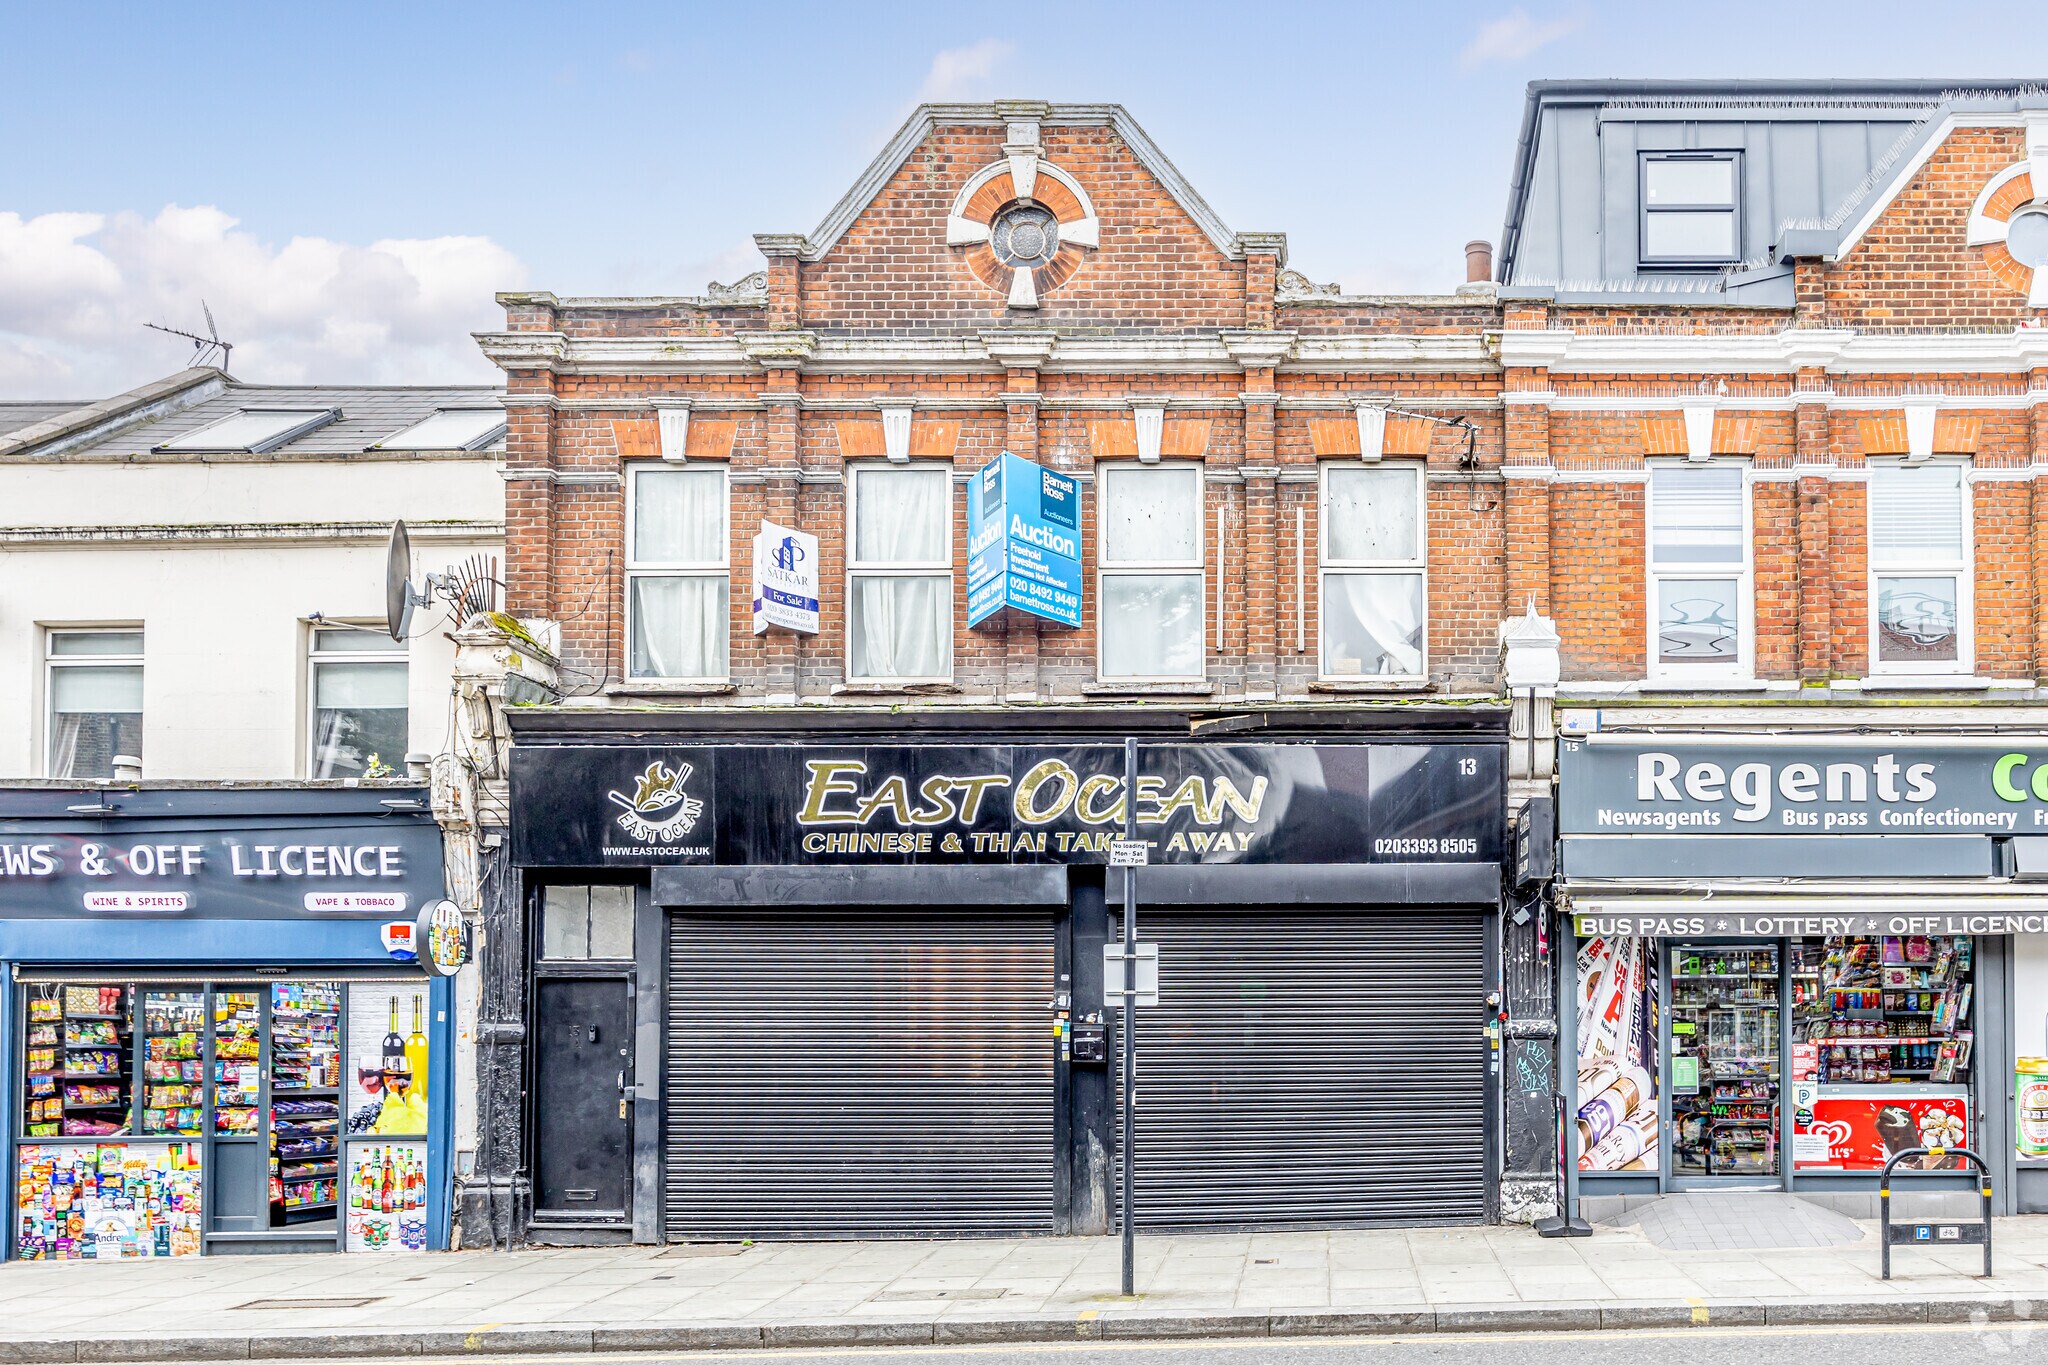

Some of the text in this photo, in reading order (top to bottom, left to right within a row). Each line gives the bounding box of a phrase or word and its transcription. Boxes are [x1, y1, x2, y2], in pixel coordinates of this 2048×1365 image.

[1042, 471, 1074, 495] Barnett
[1042, 483, 1065, 502] Ross
[1009, 513, 1075, 557] Auction
[1009, 541, 1042, 562] Freehold
[1010, 553, 1050, 575] Investment
[767, 566, 809, 587] SATKAR
[773, 590, 803, 607] For Sale
[1009, 576, 1028, 593] 020
[1029, 583, 1053, 602] 8492
[1054, 590, 1078, 609] 9449
[1009, 589, 1077, 621] barnettross.co.uk
[1565, 742, 1579, 752] 15
[1458, 758, 1477, 775] 13
[796, 758, 1269, 826] EAST OCEAN
[1637, 752, 1938, 822] Regents
[1598, 808, 1722, 830] Newsagents
[1782, 809, 1819, 826] Bus
[1824, 812, 1868, 830] pass
[1879, 808, 2018, 830] Confectionery
[602, 846, 710, 856] WWW.EASTOCEAN.UK
[802, 832, 933, 853] CHINESE
[940, 833, 965, 853] &
[970, 832, 1047, 852] THAI
[1055, 832, 1128, 852] TAK
[1165, 832, 1256, 852] AWAY
[1374, 838, 1477, 854] 0203393 8505
[0, 843, 401, 876] WS & OFF LICENCE
[92, 897, 183, 907] WINE & SPIRITS
[315, 898, 395, 906] VAPE & TOBBACO
[1580, 918, 1632, 936] BUS
[1638, 918, 1705, 936] PASS
[1739, 917, 1855, 935] LOTTERY
[1888, 916, 1940, 935] OFF
[1920, 1228, 1928, 1238] P
